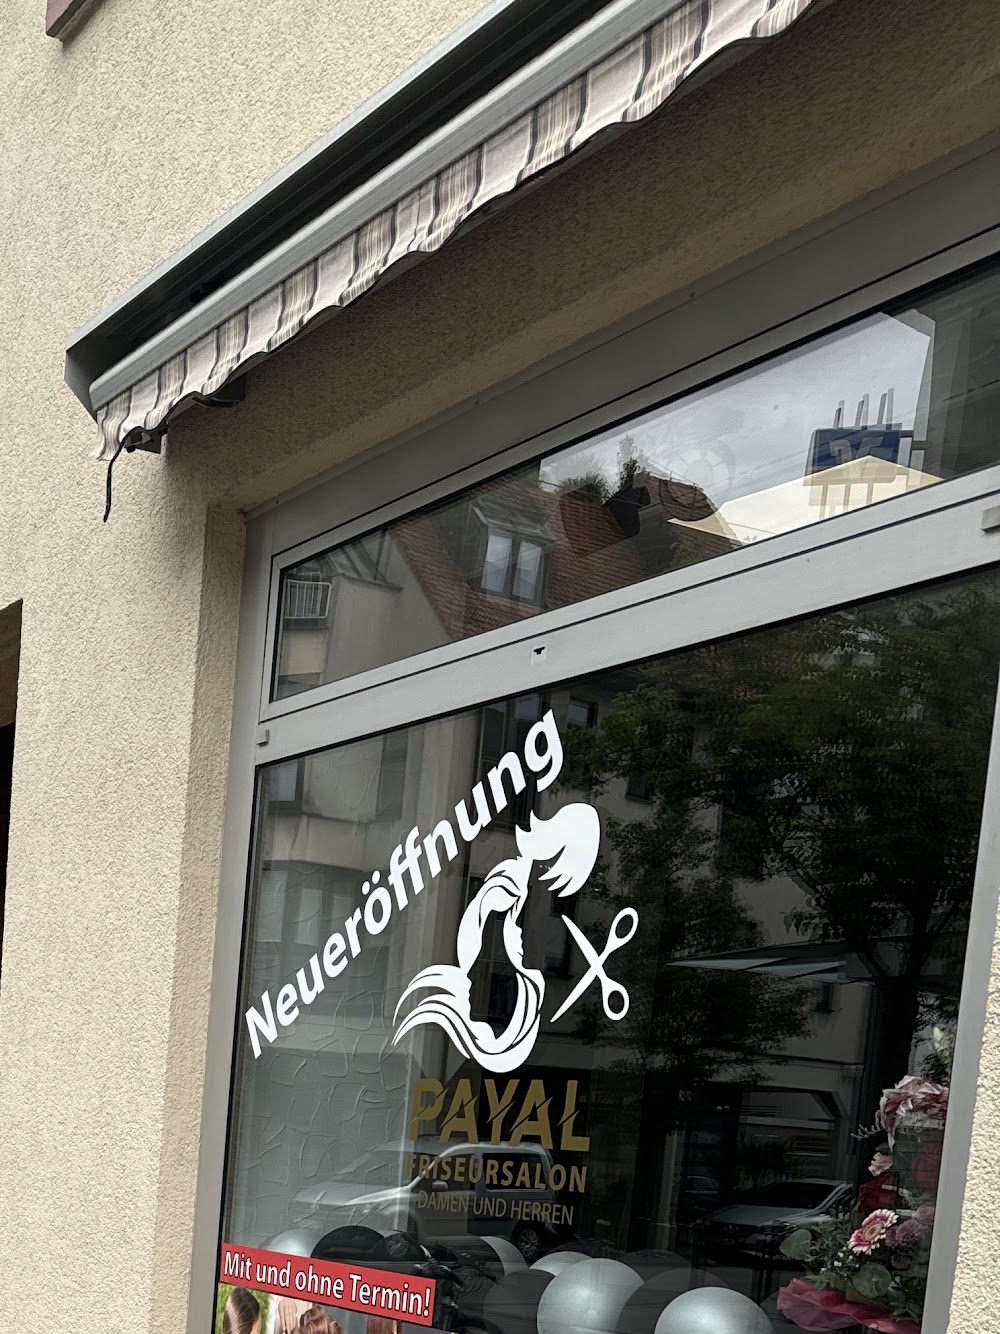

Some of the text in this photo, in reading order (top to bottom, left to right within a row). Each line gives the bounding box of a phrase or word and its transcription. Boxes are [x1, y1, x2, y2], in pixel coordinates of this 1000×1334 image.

[245, 709, 564, 1060] Neueröffnung
[409, 1078, 591, 1151] PAYAL
[406, 1154, 587, 1193] FRISEURSALON
[417, 1190, 574, 1225] DAMEN UND HERREN
[224, 1251, 432, 1317] Mit und ohne Termin!
